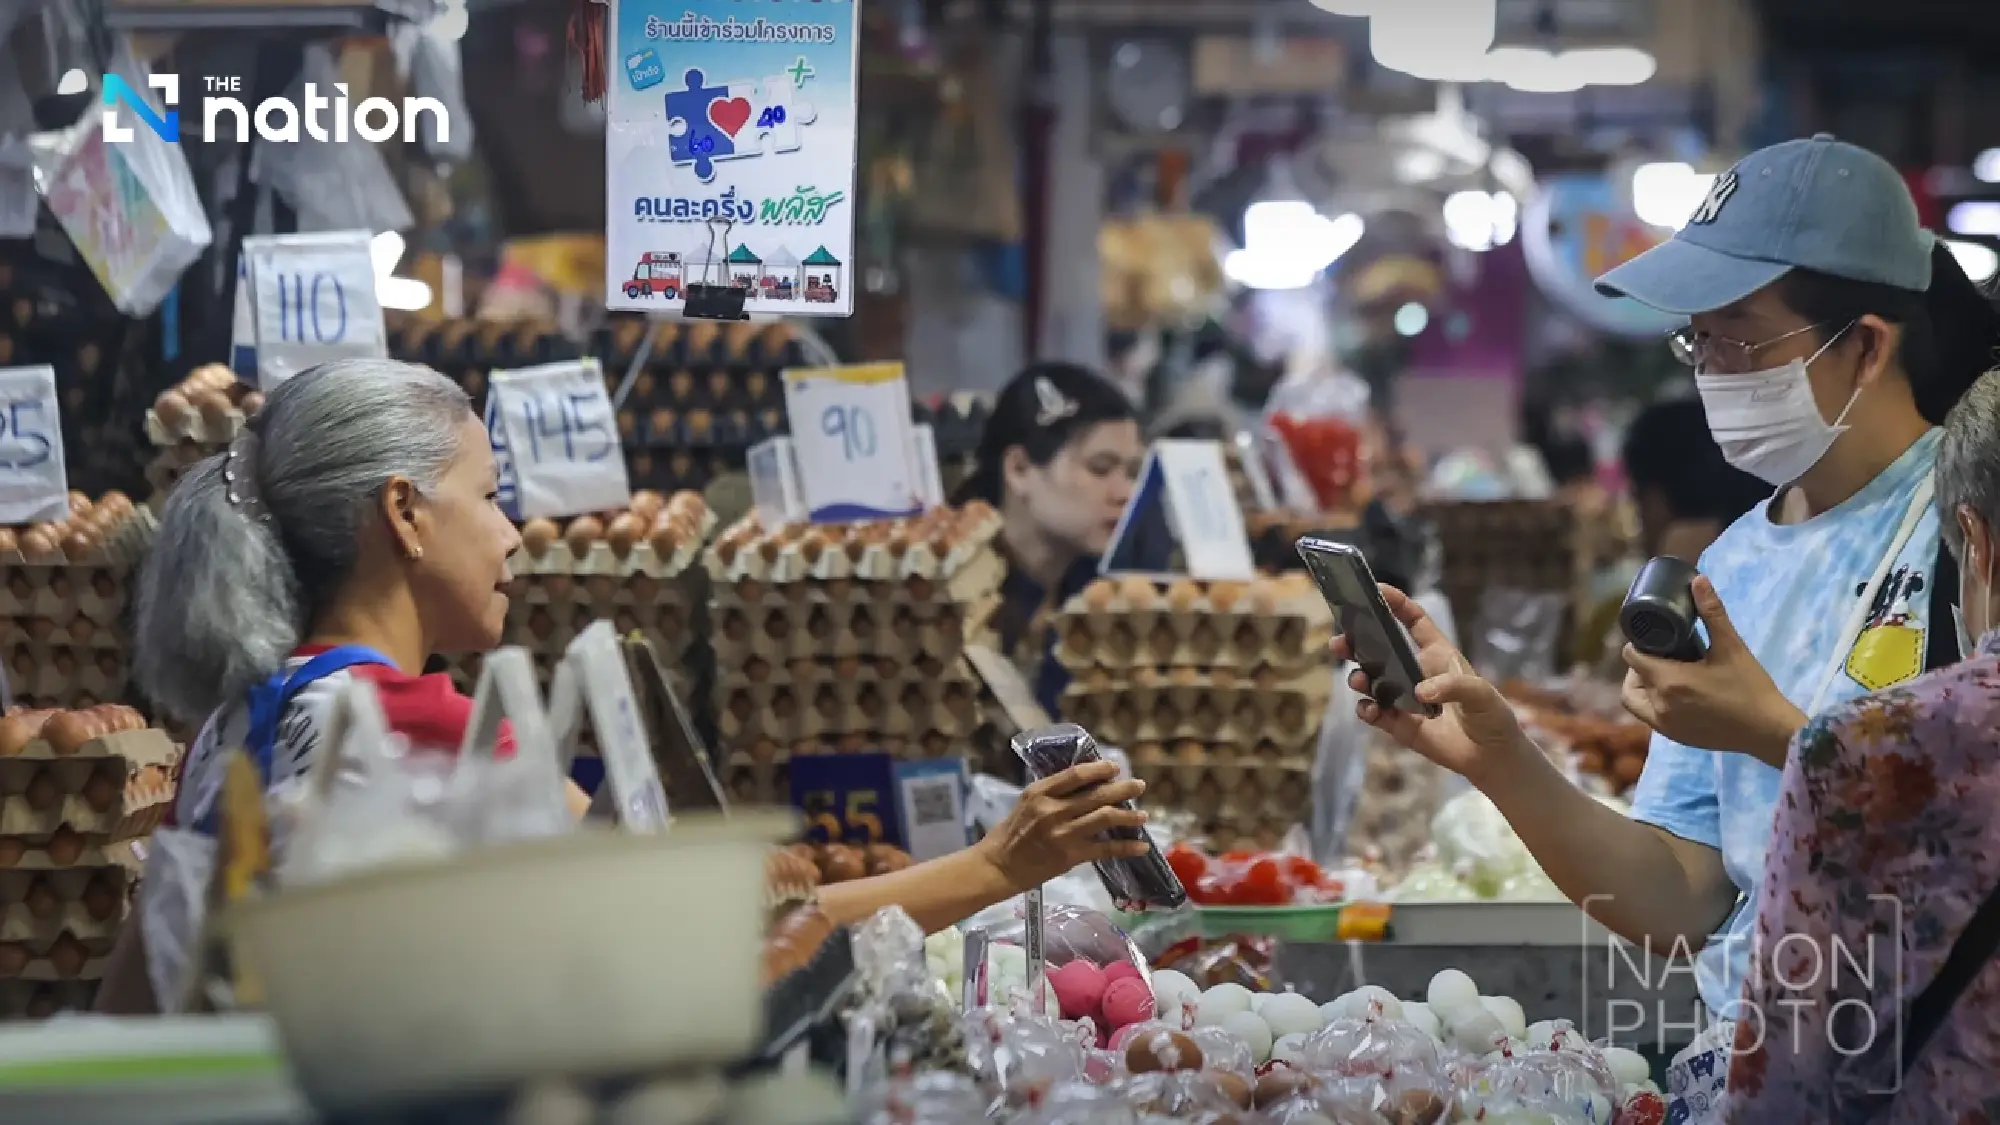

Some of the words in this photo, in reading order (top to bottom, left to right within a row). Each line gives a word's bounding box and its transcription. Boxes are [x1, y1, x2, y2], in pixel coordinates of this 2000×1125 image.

[646, 12, 834, 41] ร้านนี้เข้าร่วมโครงการ
[756, 105, 786, 128] 40
[688, 129, 715, 154] 60
[634, 185, 754, 218] คนละครึ่ง
[759, 185, 843, 221] พลัส
[277, 272, 347, 345] 110
[522, 391, 612, 464] 145
[821, 404, 878, 463] 90
